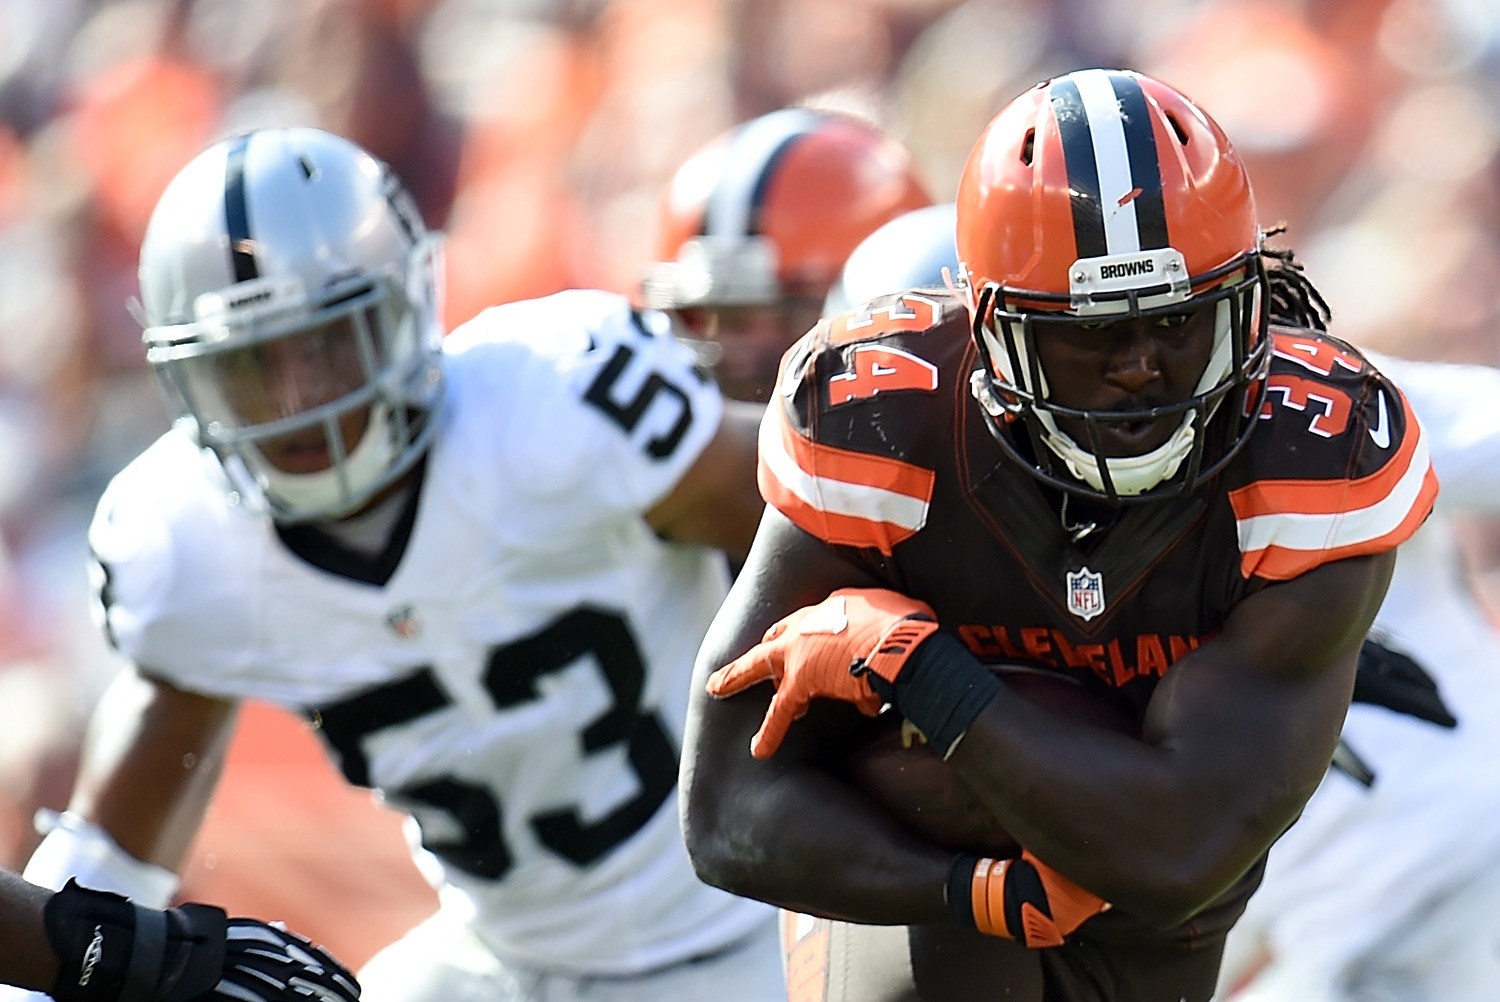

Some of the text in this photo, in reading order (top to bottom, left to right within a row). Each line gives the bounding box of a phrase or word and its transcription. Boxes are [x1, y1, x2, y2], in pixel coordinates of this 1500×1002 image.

[1100, 259, 1154, 279] BROWNS
[583, 310, 708, 460] 5
[828, 293, 939, 408] 34
[1241, 332, 1363, 439] 34
[1074, 591, 1099, 610] NFL
[958, 624, 1222, 688] CLEVELAN
[300, 604, 681, 882] 53
